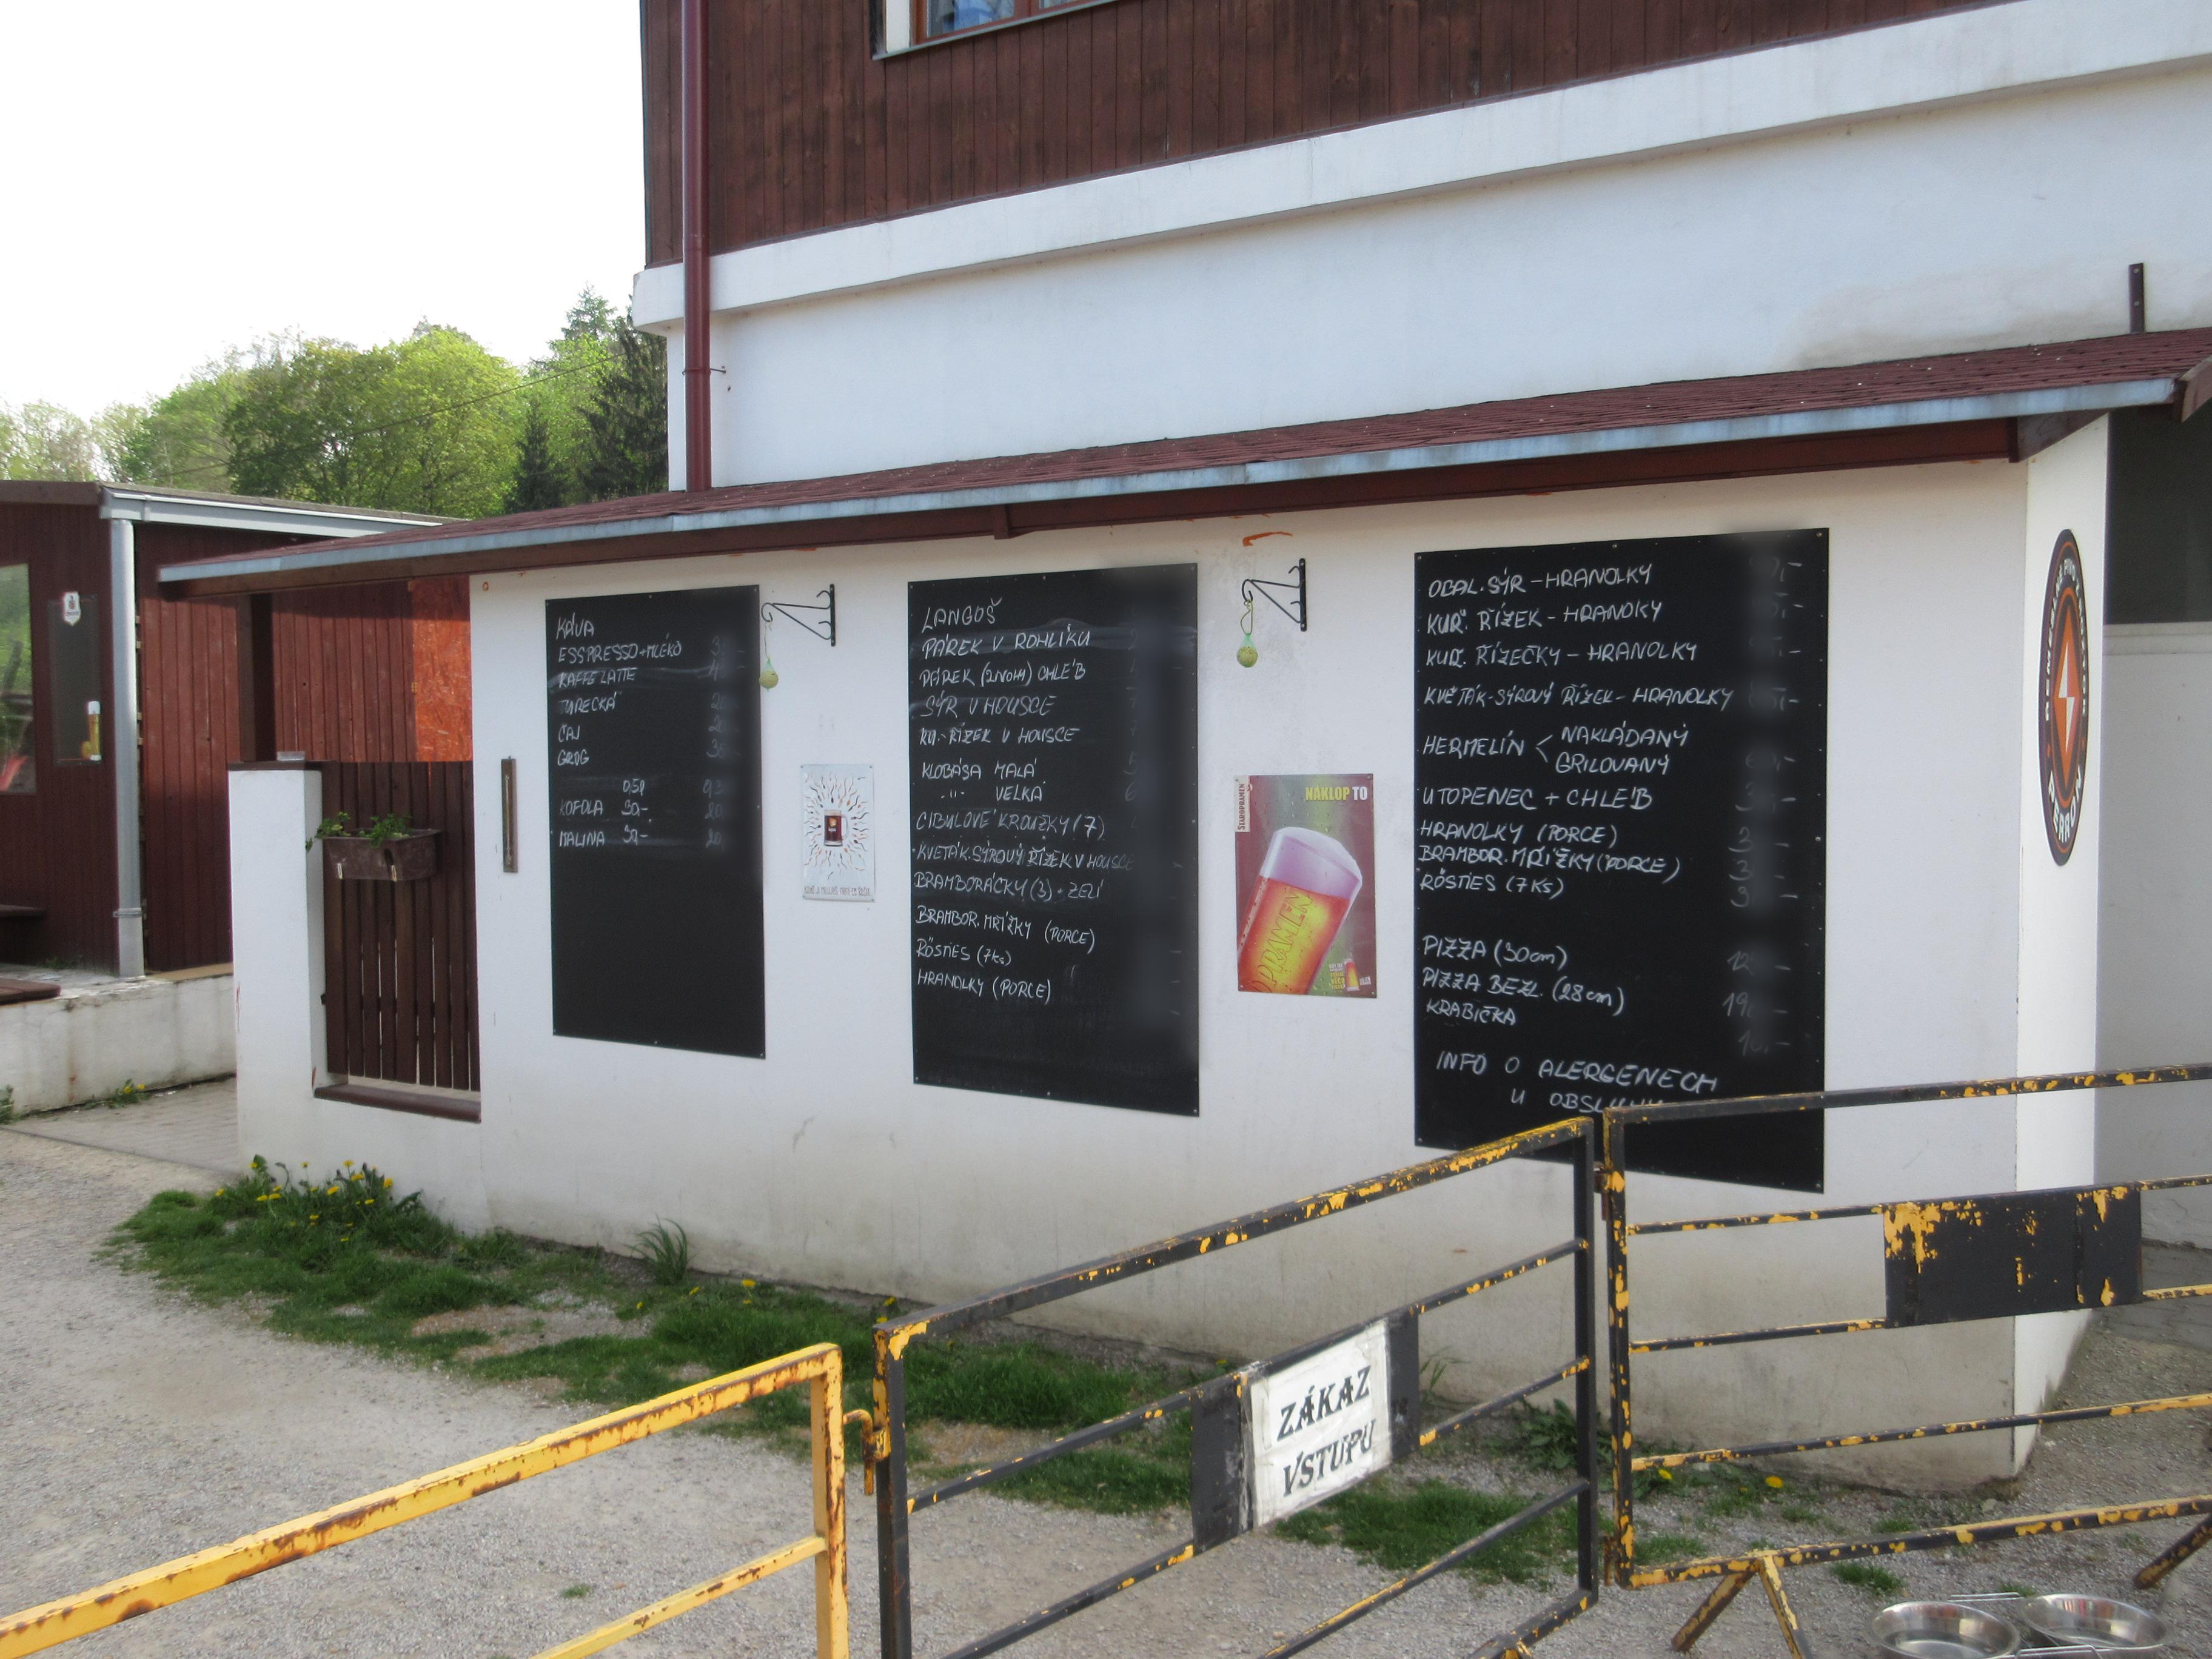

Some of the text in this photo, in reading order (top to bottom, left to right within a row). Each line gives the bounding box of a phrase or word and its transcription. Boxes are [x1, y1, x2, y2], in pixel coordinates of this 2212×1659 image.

[1487, 566, 1527, 595] SÝR
[1545, 563, 1652, 588] HRANOLKY
[556, 612, 594, 639] KÁVA
[922, 598, 1002, 633] LANGOŠ
[1478, 602, 1543, 631] ŘÍZEK
[922, 623, 1091, 659] PÁREK V ROHLÍKU
[1475, 641, 1561, 667] ŘÍZEČKY
[1587, 642, 1697, 662] HRANOLKY
[919, 667, 976, 688] PÁREK
[1037, 658, 1086, 681] CHLÉB
[920, 690, 958, 718] SÝR
[982, 695, 1057, 716] HOUSCE
[1632, 687, 1734, 712] HRANOLKY
[558, 724, 580, 743] ČAJ
[1017, 726, 1081, 744] HOUSCE
[1423, 730, 1525, 759] HERMELÍN
[1561, 720, 1689, 747] NAKLÁDANÝ
[557, 749, 589, 766] GROG
[922, 757, 1037, 780] KLOBÁSA MALÁ
[996, 781, 1047, 802] VELKÁ
[1305, 786, 1368, 801] NAKLOP TO
[1423, 787, 1538, 809] UTOPENEC
[1566, 786, 1653, 810] CHLÉB
[2048, 764, 2082, 843] PERRON
[560, 799, 603, 816] KOFOLA
[916, 809, 997, 831] CIBULOVÉ
[1237, 783, 1245, 830] STAROPRAMEN
[559, 830, 605, 848] MALINA
[1420, 820, 1618, 848] HRANOLKY (PORCE)
[1074, 854, 1085, 869] V
[1044, 919, 1096, 954] (PORCE)
[1423, 935, 1486, 960] PIZZA
[1493, 939, 1567, 971] (30cm)
[917, 968, 1051, 1005] HRANOLKY (PORCE)
[1423, 967, 1481, 992] PIZZA
[1427, 999, 1516, 1025] KRABIČKA
[1436, 1050, 1717, 1093] INFO O ALERGENECH
[1510, 1088, 1664, 1113] U OBSL
[1276, 1365, 1372, 1442] ZÁKAZ
[1282, 1418, 1377, 1498] VSTUPU
